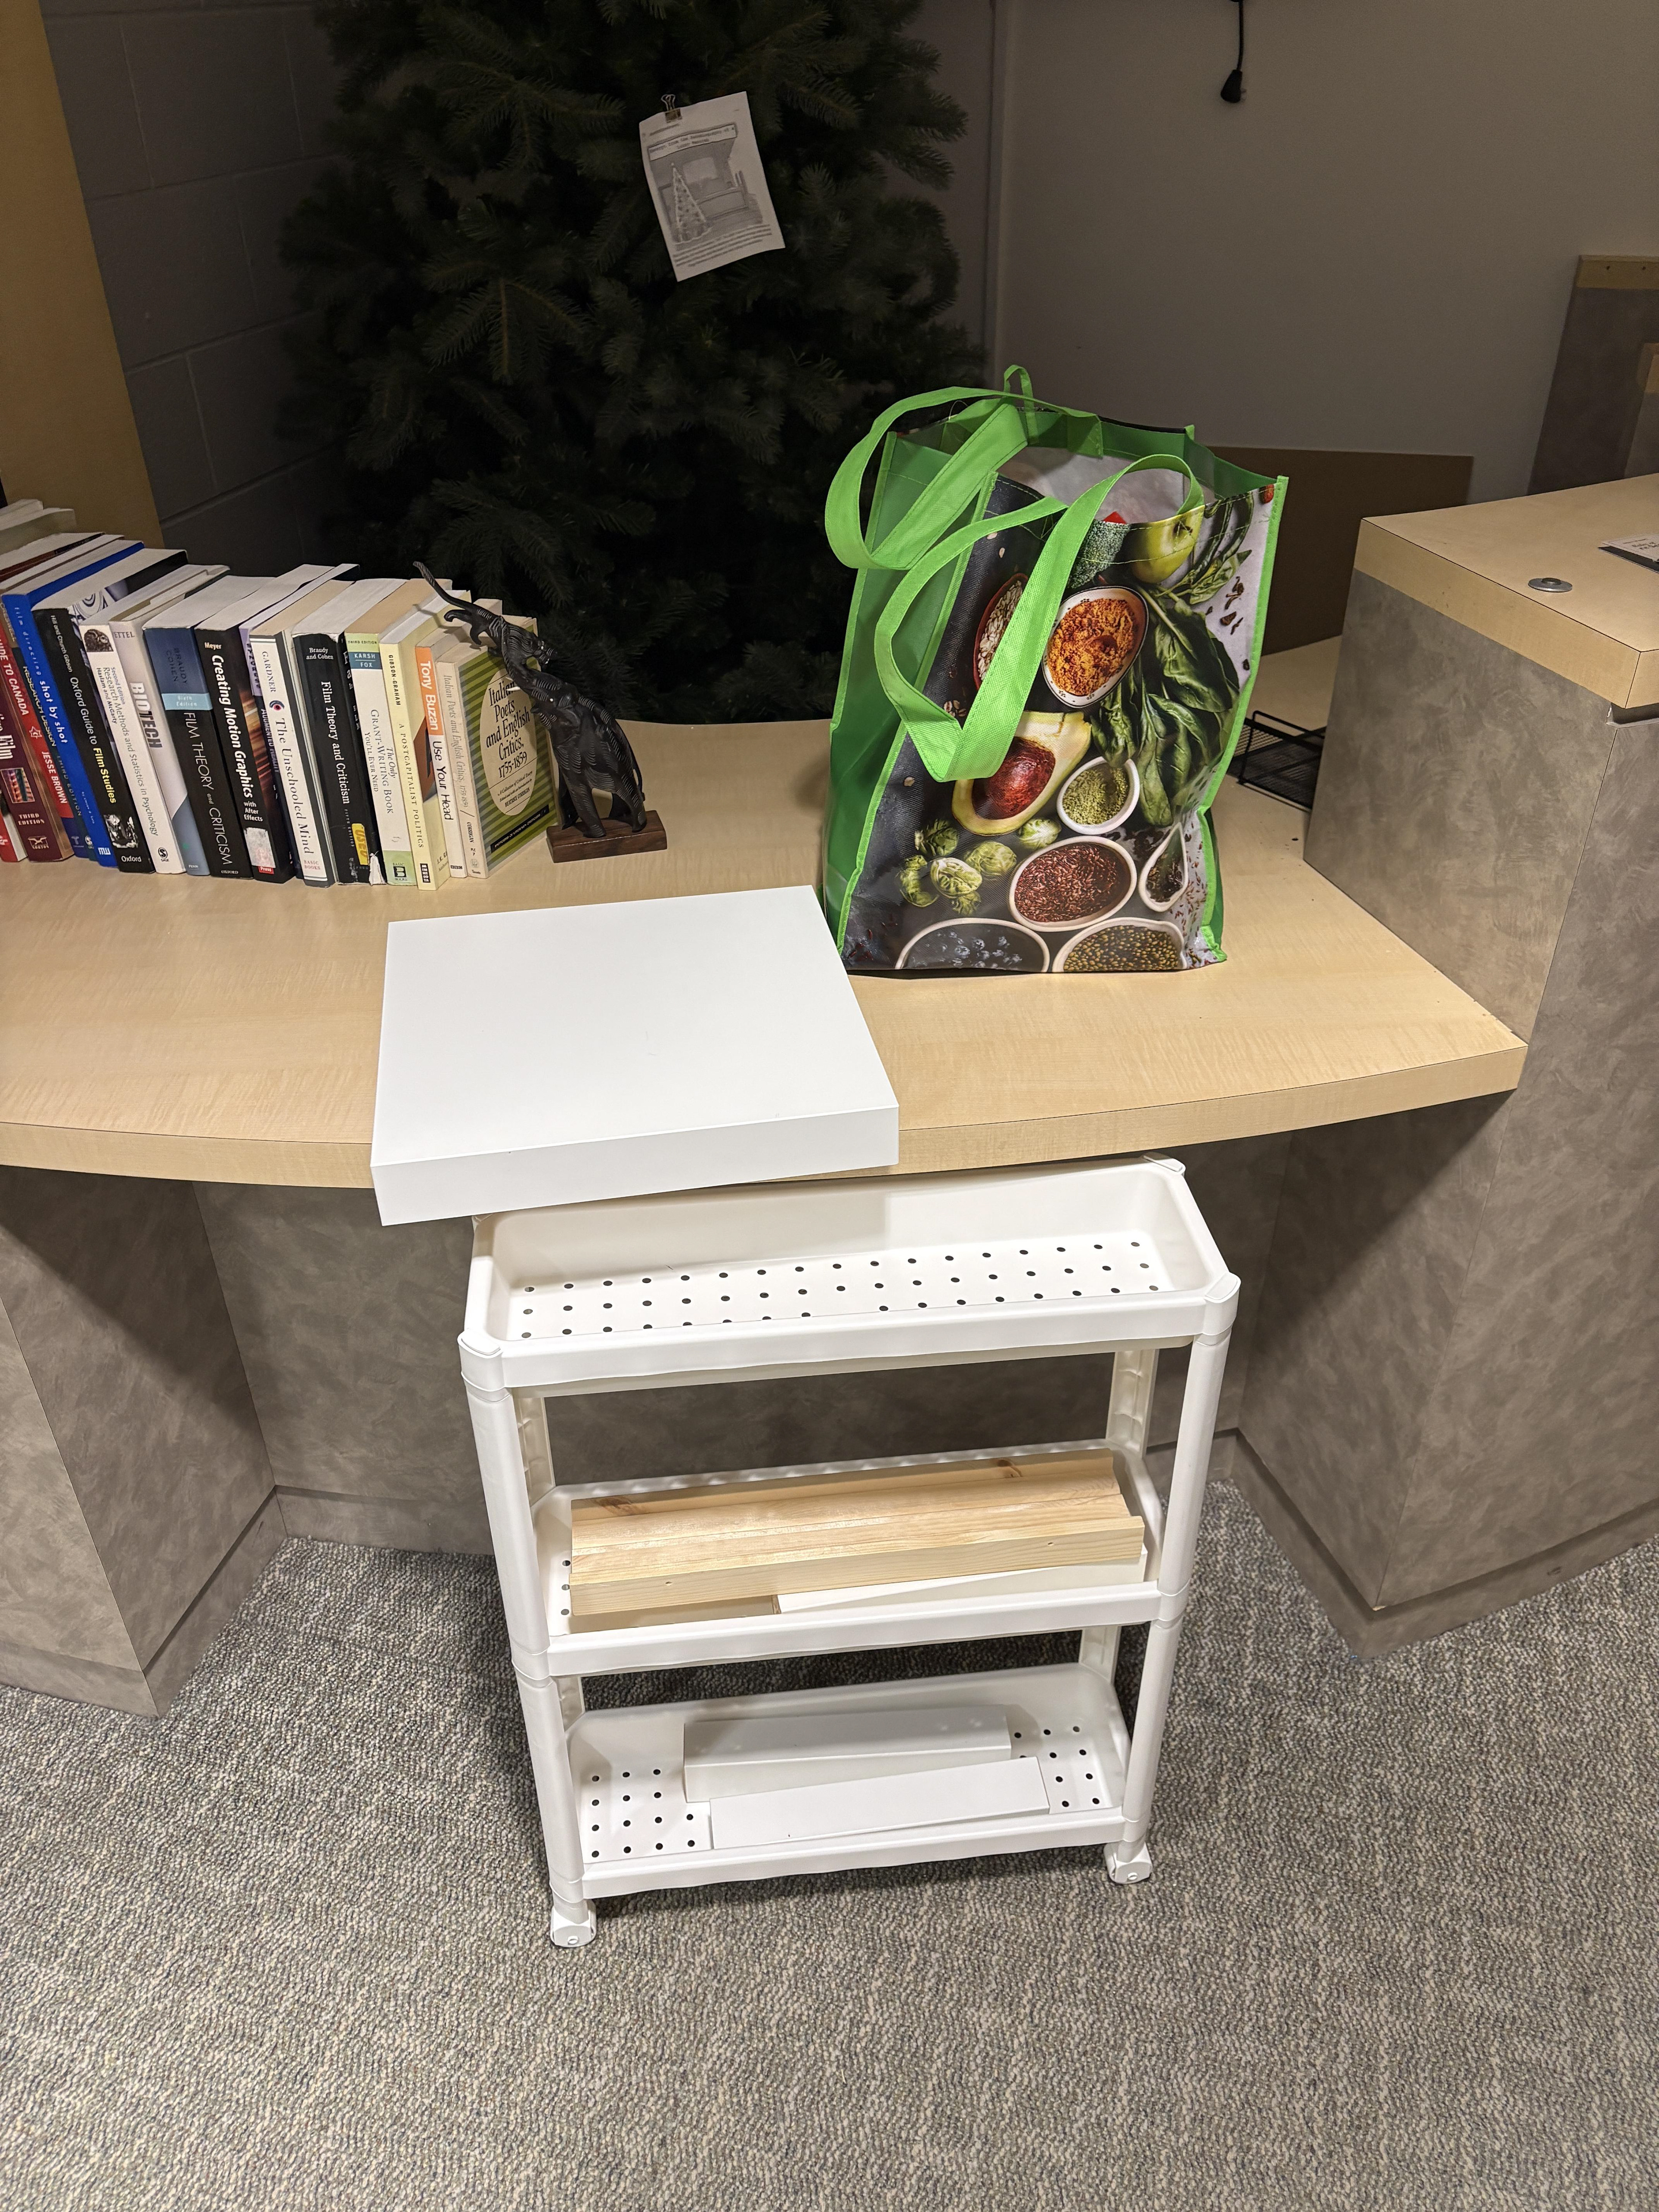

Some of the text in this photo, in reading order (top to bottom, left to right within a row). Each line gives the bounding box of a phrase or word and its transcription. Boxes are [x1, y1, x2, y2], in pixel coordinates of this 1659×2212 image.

[57, 635, 67, 657] Church
[64, 654, 73, 673] Gibson
[167, 650, 178, 682] COHEN
[175, 648, 187, 683] BRAUDY
[262, 652, 276, 692] GARDNER
[3, 663, 14, 675] TO
[9, 677, 29, 715] CANADA
[96, 668, 106, 689] Haslam
[107, 701, 117, 724] McGarty
[111, 667, 125, 705] Second Edition
[388, 655, 401, 706] GIBSON-GRAHAM
[420, 661, 439, 731] Tony Buzan
[444, 675, 454, 698] Italian
[488, 680, 515, 706] Italian
[40, 680, 68, 743] shot by shot
[130, 682, 162, 748] BIOTECH
[212, 655, 254, 798] Creating Motion Graphics
[447, 701, 456, 718] Poets
[451, 720, 459, 734] and
[486, 706, 530, 748] and English
[495, 700, 515, 722] Poets
[70, 677, 116, 804] Oxford Guide to Film Studies
[103, 667, 119, 702] Research
[114, 703, 129, 736] Methods
[125, 737, 134, 753] and
[130, 754, 144, 789] Statistics
[142, 797, 159, 836] Psychology
[321, 681, 350, 804] Film Theory and Criticism
[371, 709, 394, 814] GRANT-WRITING BOOK
[452, 735, 463, 763] English
[499, 737, 524, 760] Critics,
[42, 751, 67, 804] JESSE BROWN
[276, 718, 314, 854] The Unschooled Mind
[388, 762, 397, 779] Only
[433, 741, 454, 820] Use Your Head
[499, 751, 527, 779] 1755-1859
[67, 783, 82, 816] EDITION
[184, 712, 200, 738] FILM
[192, 742, 214, 790] THEORY
[210, 807, 232, 865] CRITICISM
[401, 733, 417, 805] POSTCAPITALIST
[413, 809, 424, 848] POLITICS
[355, 830, 367, 858] USED
